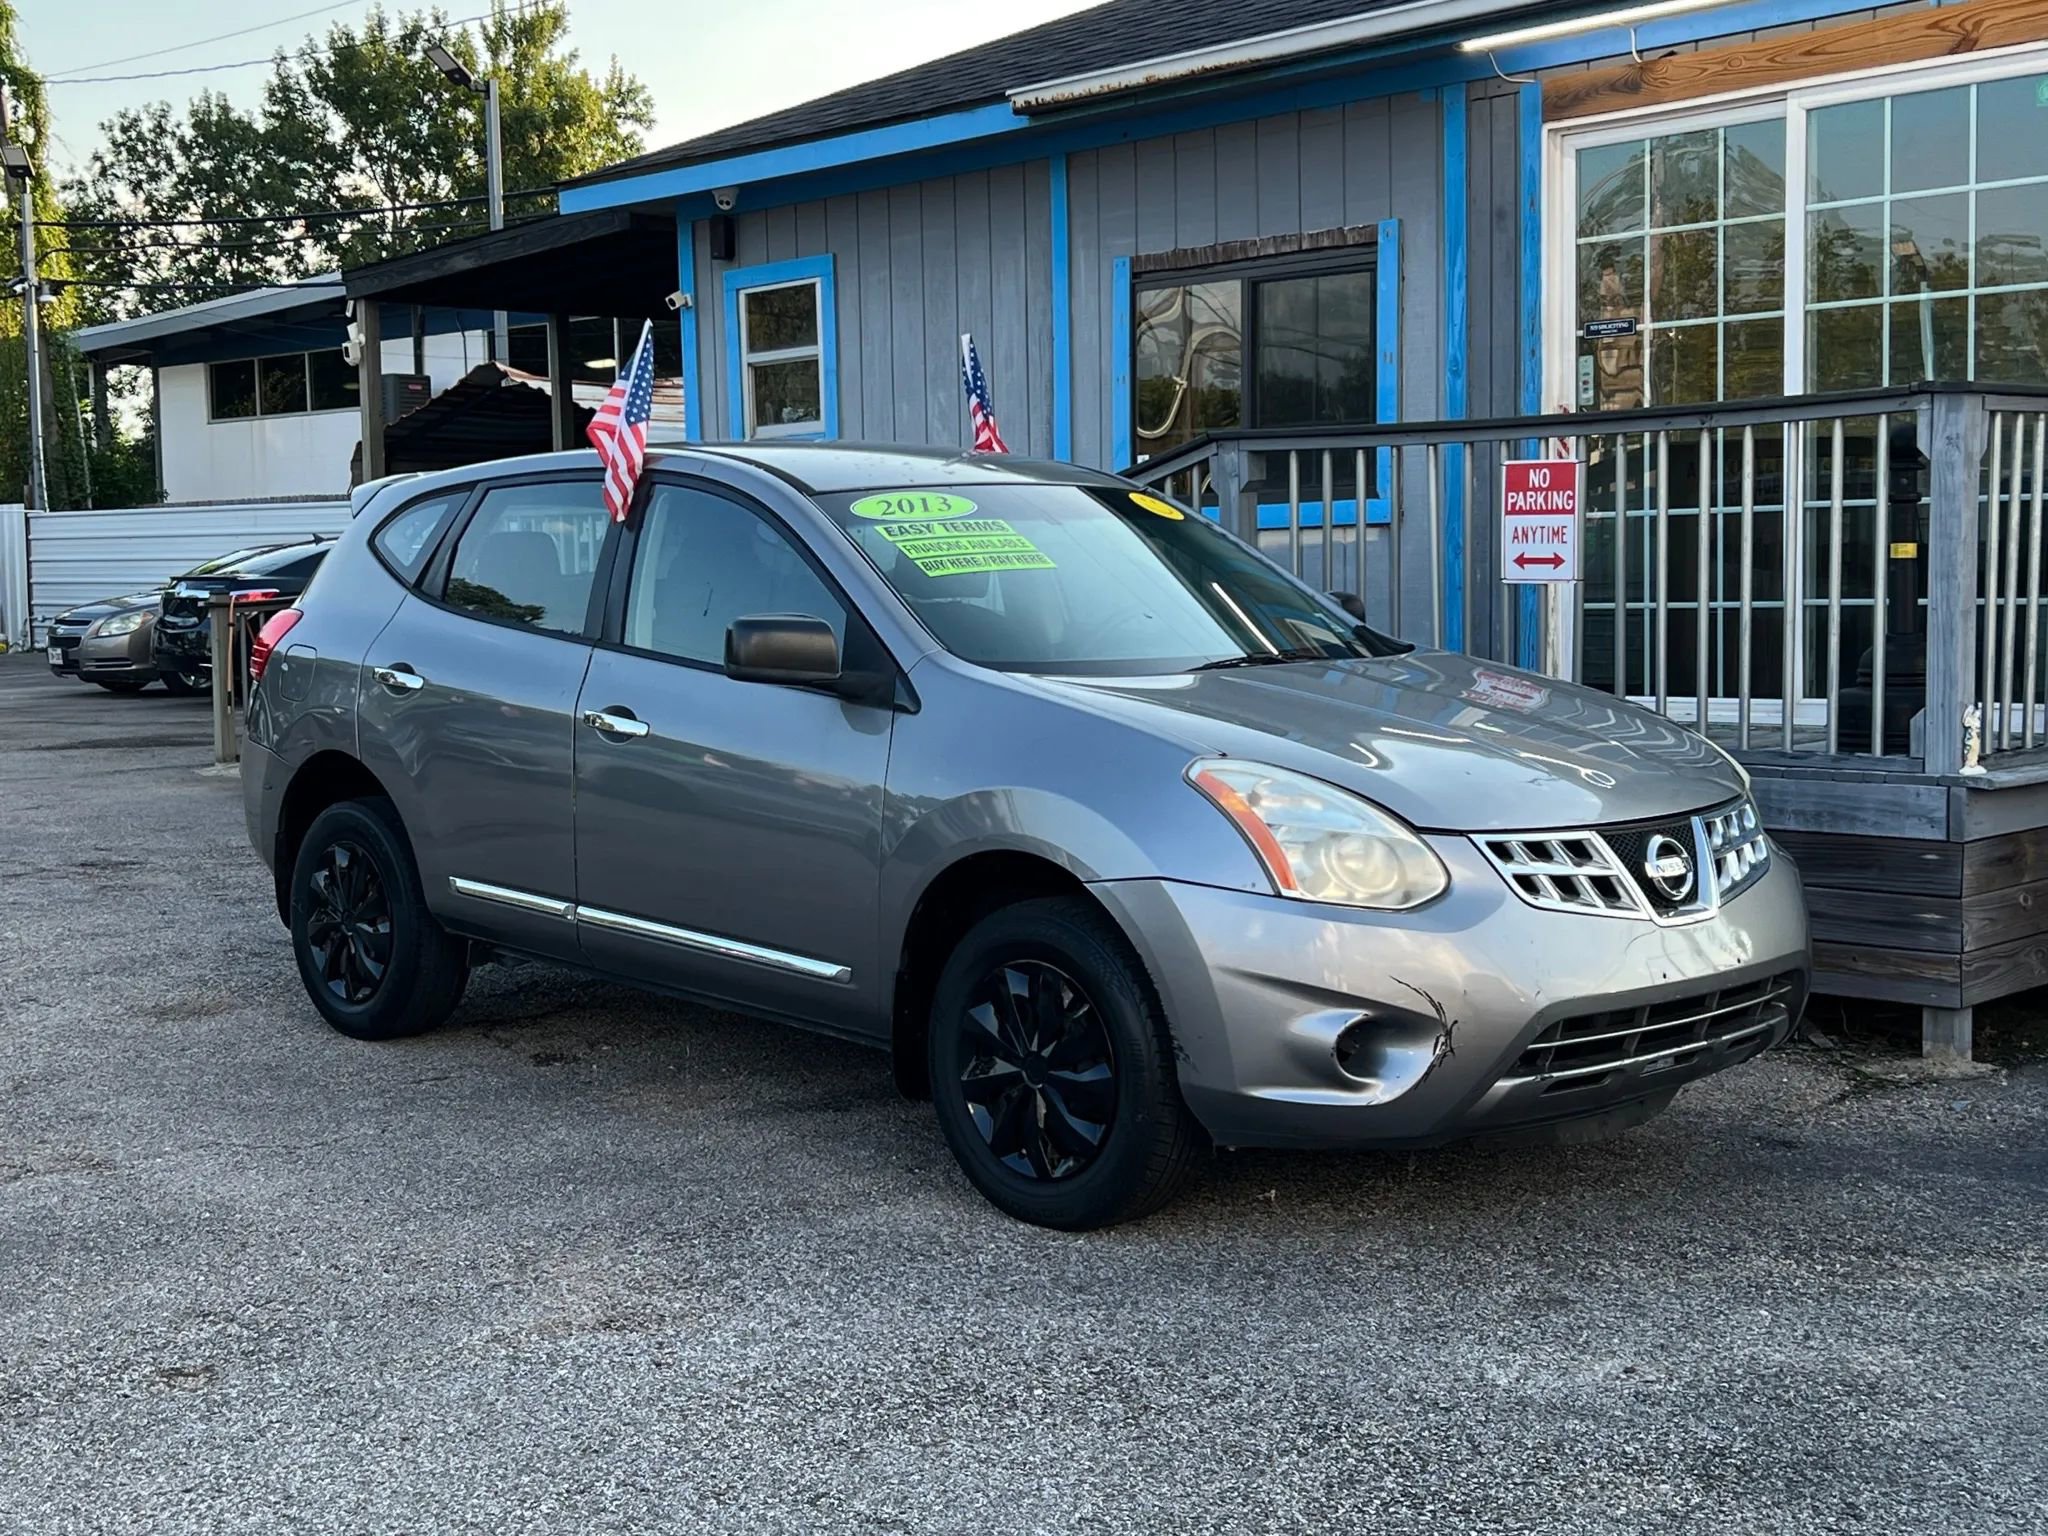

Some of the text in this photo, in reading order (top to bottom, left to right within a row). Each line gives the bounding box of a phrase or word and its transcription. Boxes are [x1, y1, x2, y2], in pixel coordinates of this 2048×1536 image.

[1529, 468, 1550, 488] NO
[876, 496, 953, 516] 2013
[1507, 490, 1574, 511] PARKING
[883, 519, 1008, 537] EASY TERMS
[1511, 525, 1568, 544] ANYTIME
[902, 537, 1032, 556] FINANCING AVAILABLE
[921, 560, 948, 572] BUY
[947, 557, 982, 569] HERE
[990, 556, 1013, 567] PAY
[1014, 553, 1048, 564] HERE
